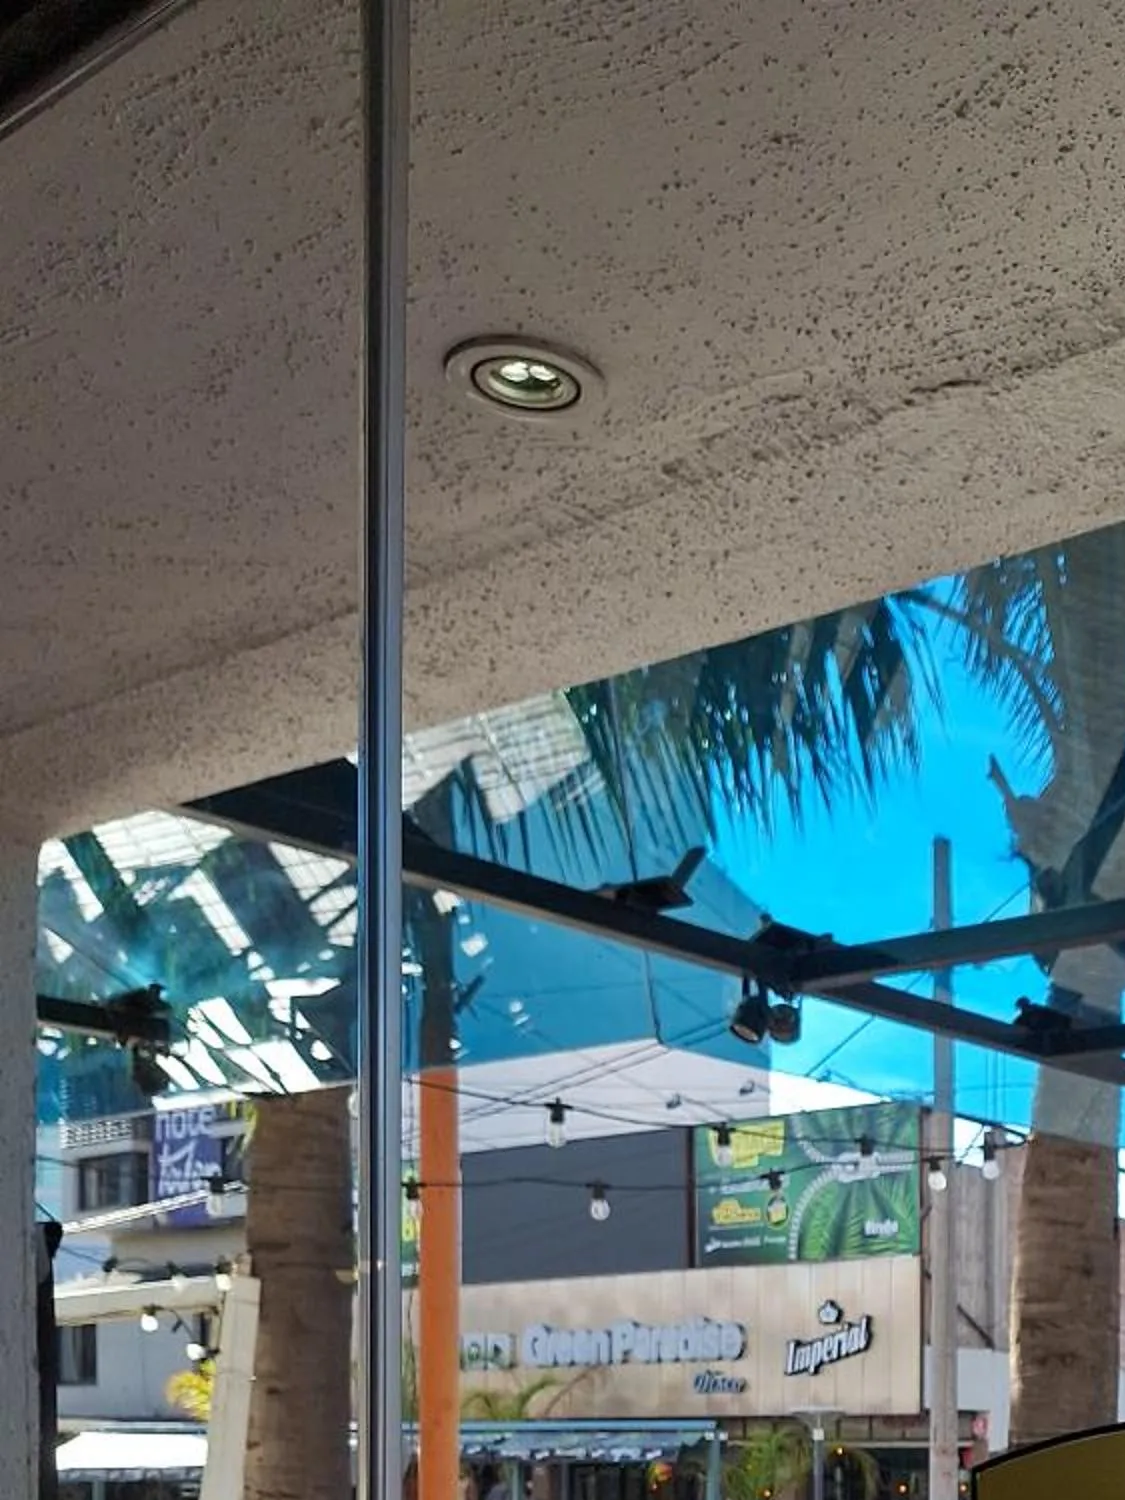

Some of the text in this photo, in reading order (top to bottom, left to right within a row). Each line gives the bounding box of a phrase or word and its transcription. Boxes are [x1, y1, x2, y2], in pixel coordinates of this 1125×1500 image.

[523, 1324, 612, 1367] Green
[613, 1317, 746, 1364] Paradise
[784, 1315, 873, 1376] Imperial
